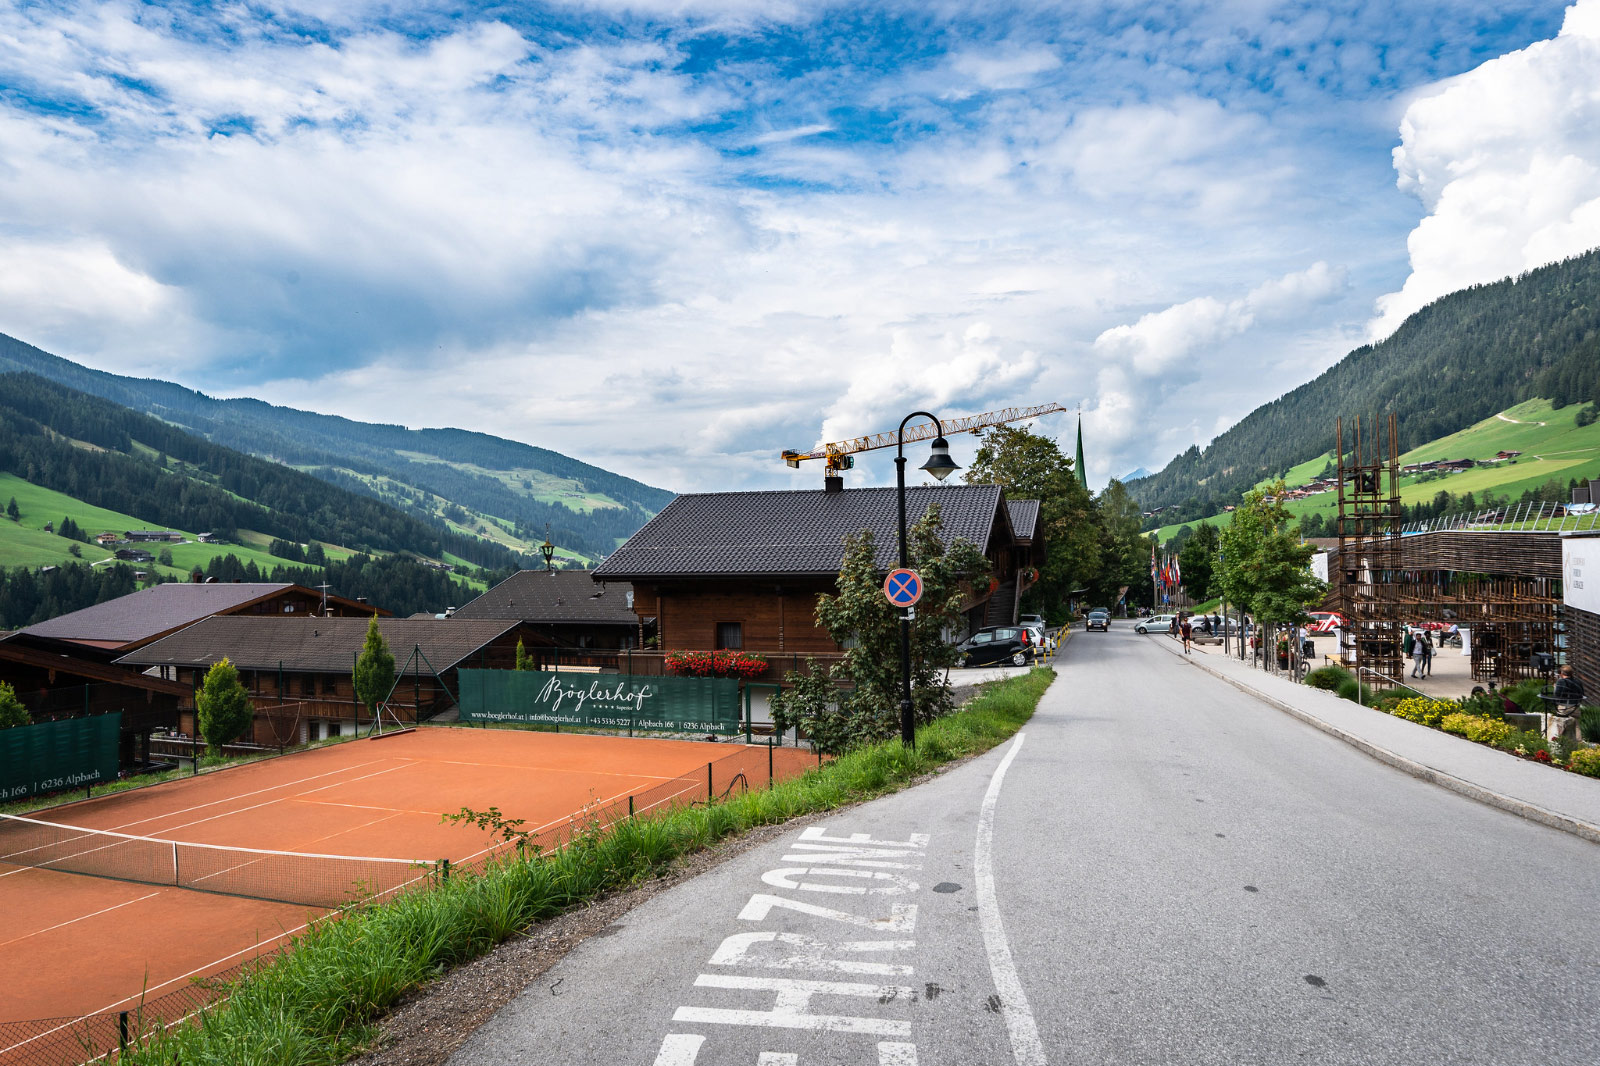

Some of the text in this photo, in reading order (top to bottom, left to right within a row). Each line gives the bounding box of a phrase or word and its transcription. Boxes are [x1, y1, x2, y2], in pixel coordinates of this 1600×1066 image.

[471, 711, 524, 721] www.boeglerhof.at
[529, 714, 581, 723] info@boeglerhof.at
[601, 717, 616, 725] 5336
[616, 718, 631, 726] 5227
[638, 720, 663, 728] Alpbach
[683, 721, 699, 729] 6236
[699, 722, 725, 731] Alpbach
[41, 778, 63, 789] 6236
[65, 769, 101, 785] Alpbach
